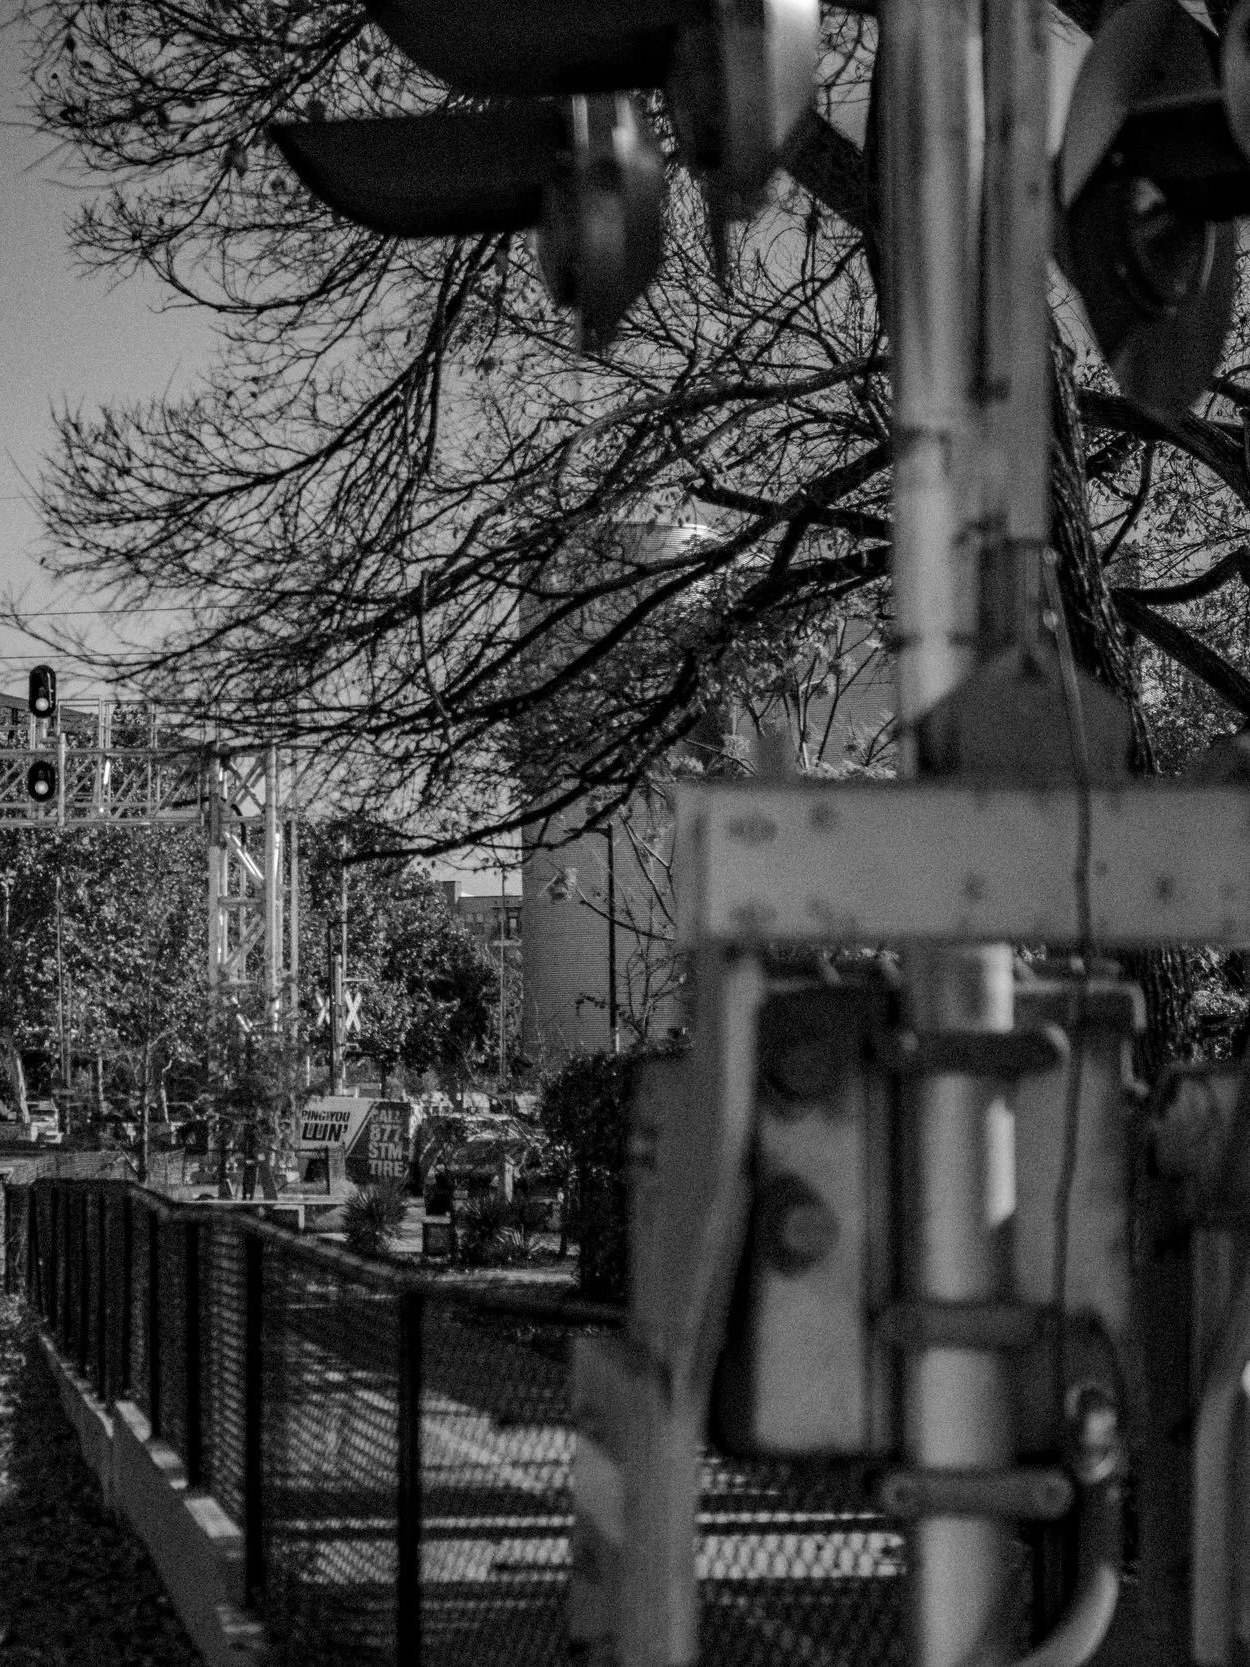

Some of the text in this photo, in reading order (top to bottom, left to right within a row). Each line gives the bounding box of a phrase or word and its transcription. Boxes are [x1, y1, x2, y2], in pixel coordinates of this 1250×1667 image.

[330, 1111, 350, 1122] YOU
[370, 1124, 403, 1142] 877
[369, 1142, 403, 1160] STM
[369, 1160, 403, 1177] TIRE
